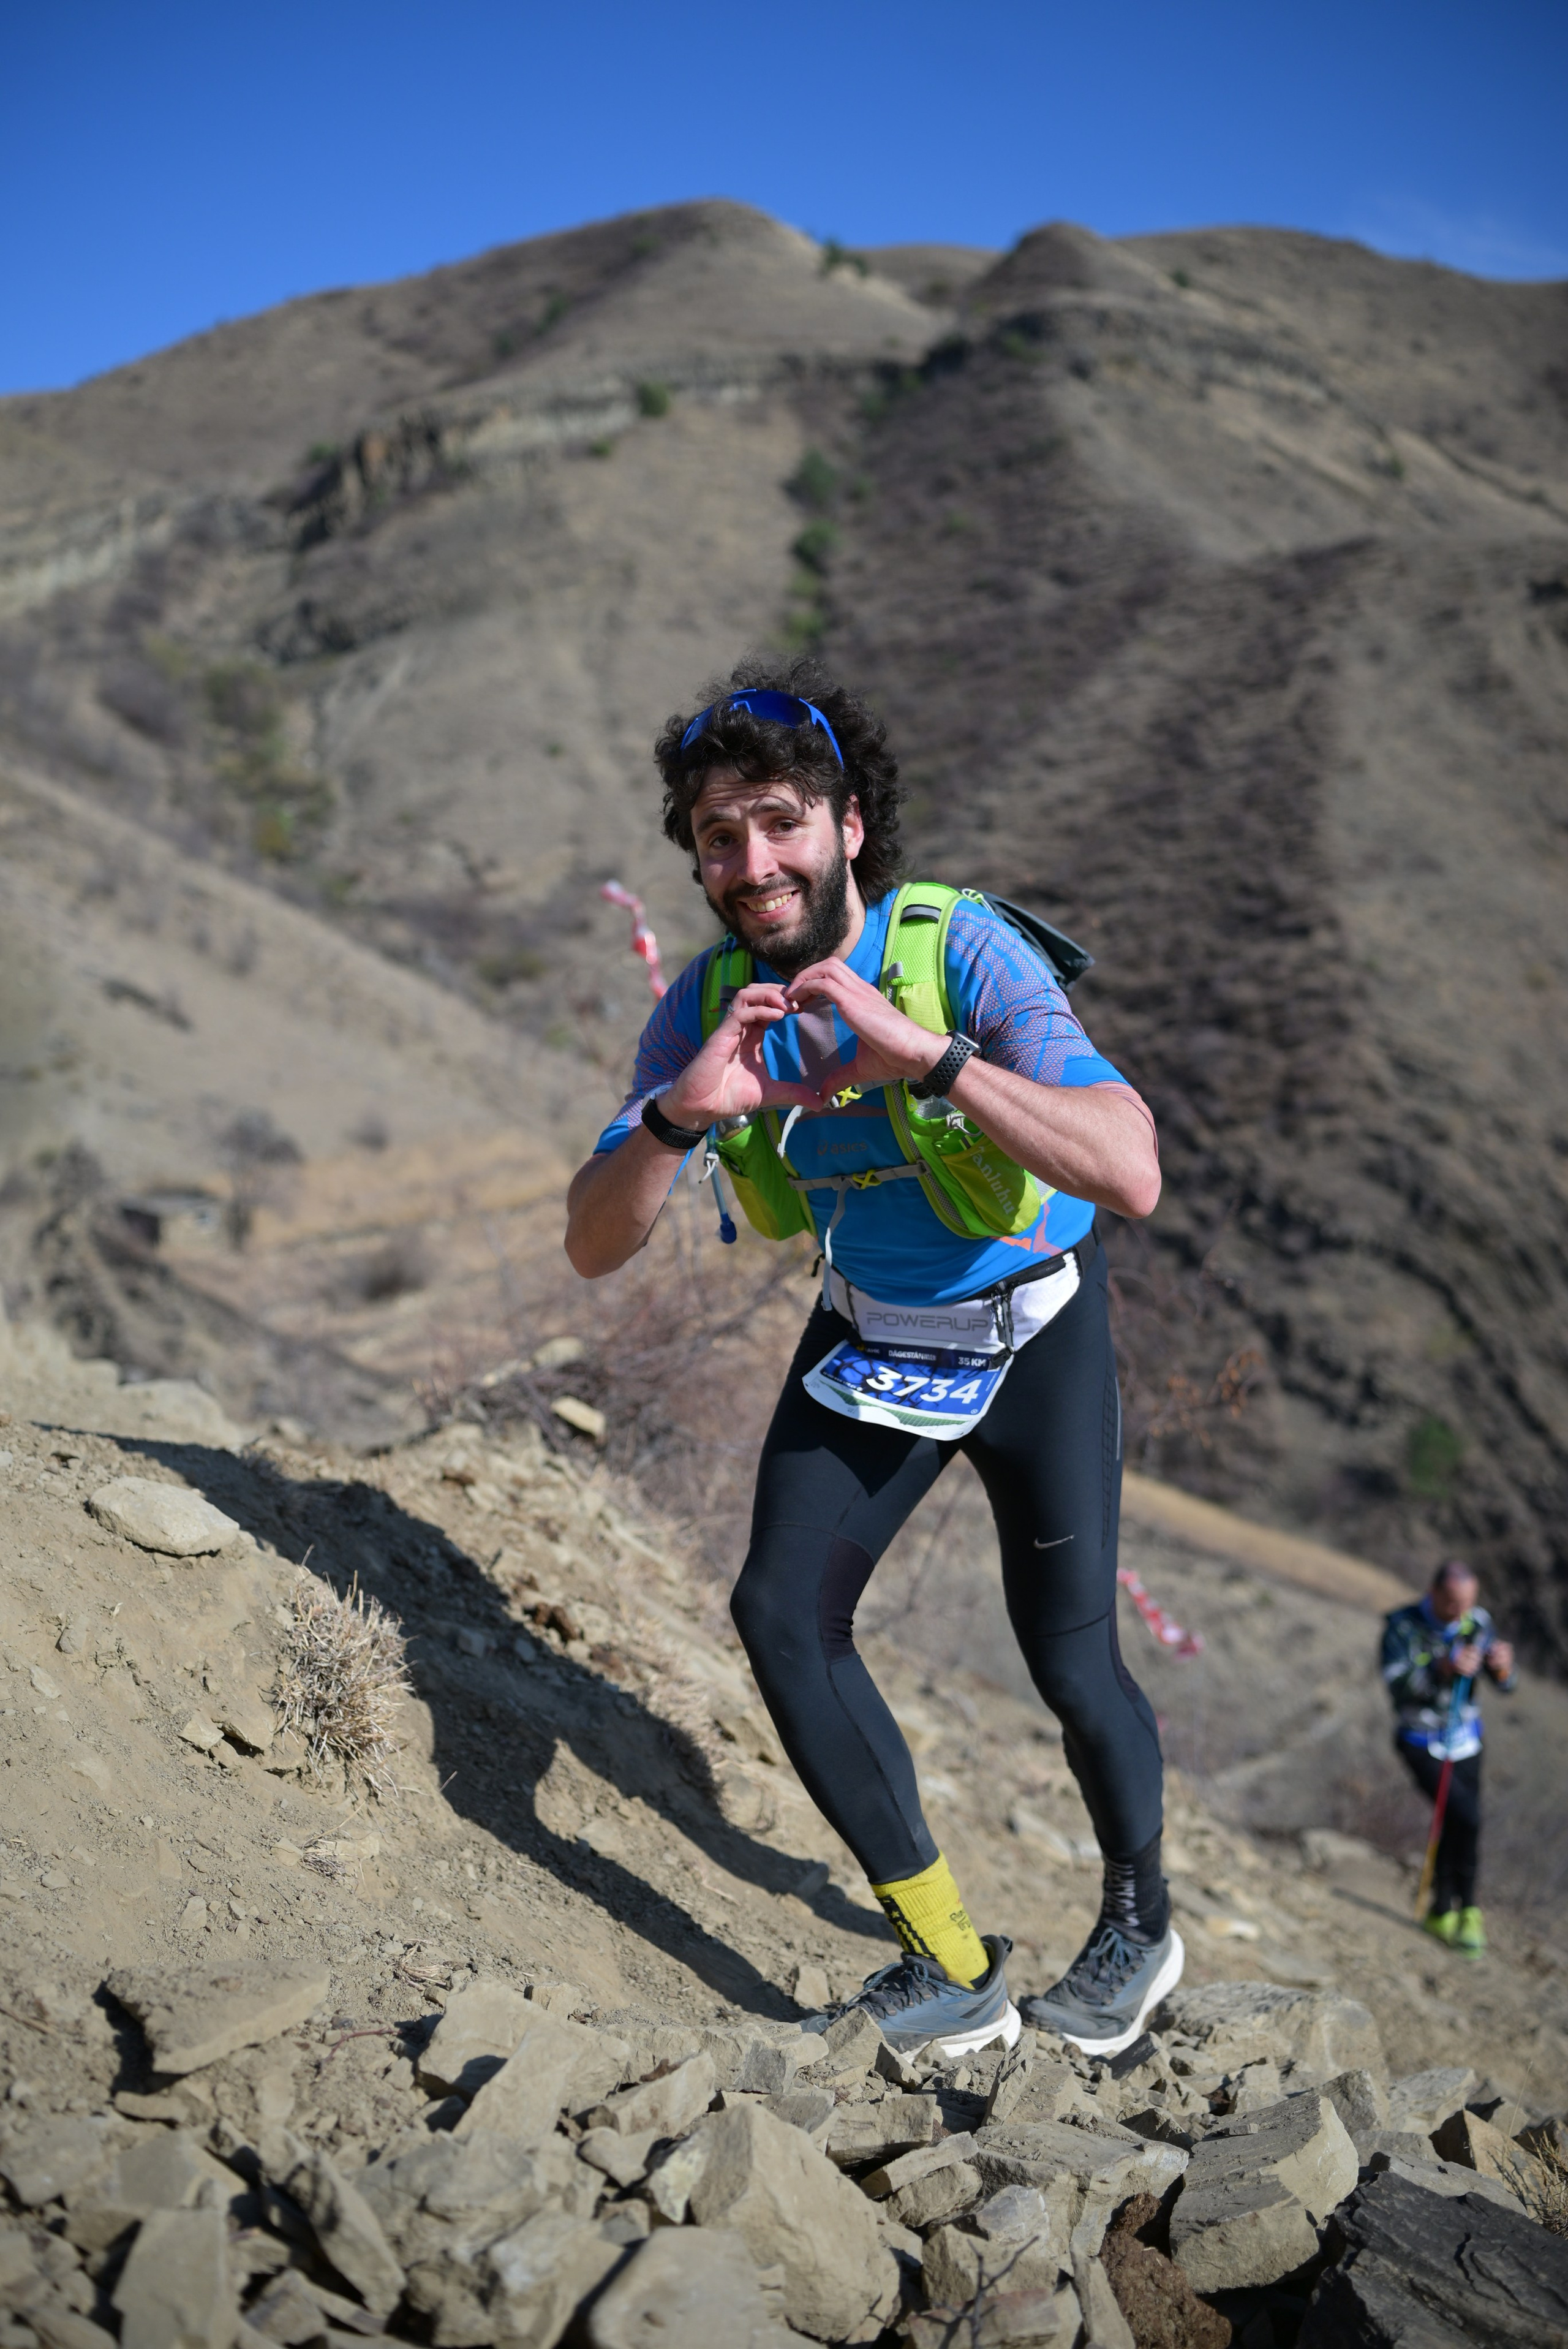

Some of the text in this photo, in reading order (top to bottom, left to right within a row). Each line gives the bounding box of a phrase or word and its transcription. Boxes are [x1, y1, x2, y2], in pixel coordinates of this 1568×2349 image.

[831, 1140, 869, 1155] asics
[970, 1146, 1015, 1215] Tanluhu
[866, 1312, 989, 1333] POWERUP
[958, 1356, 986, 1367] 35 KM
[865, 1366, 982, 1405] 3734
